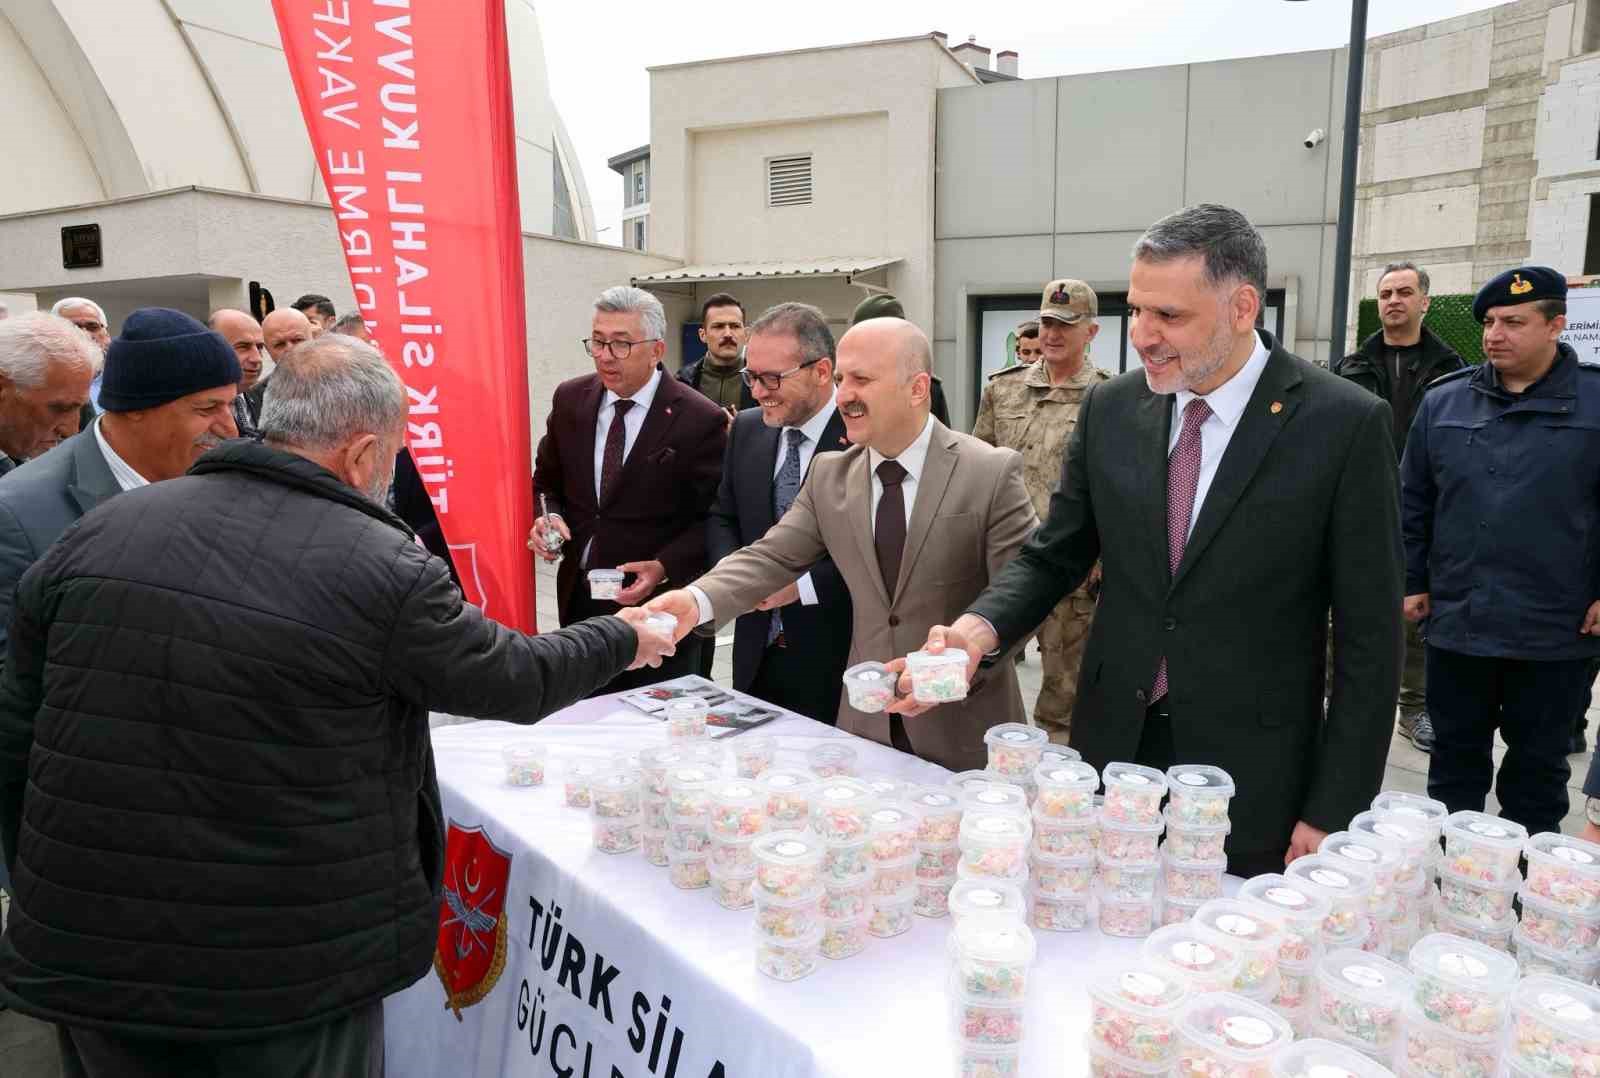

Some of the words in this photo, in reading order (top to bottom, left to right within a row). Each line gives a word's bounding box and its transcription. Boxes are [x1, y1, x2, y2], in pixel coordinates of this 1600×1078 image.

[1564, 320, 1600, 330] ERİMİ
[528, 895, 621, 1025] TÜRK
[517, 978, 625, 1078] GÜÇL
